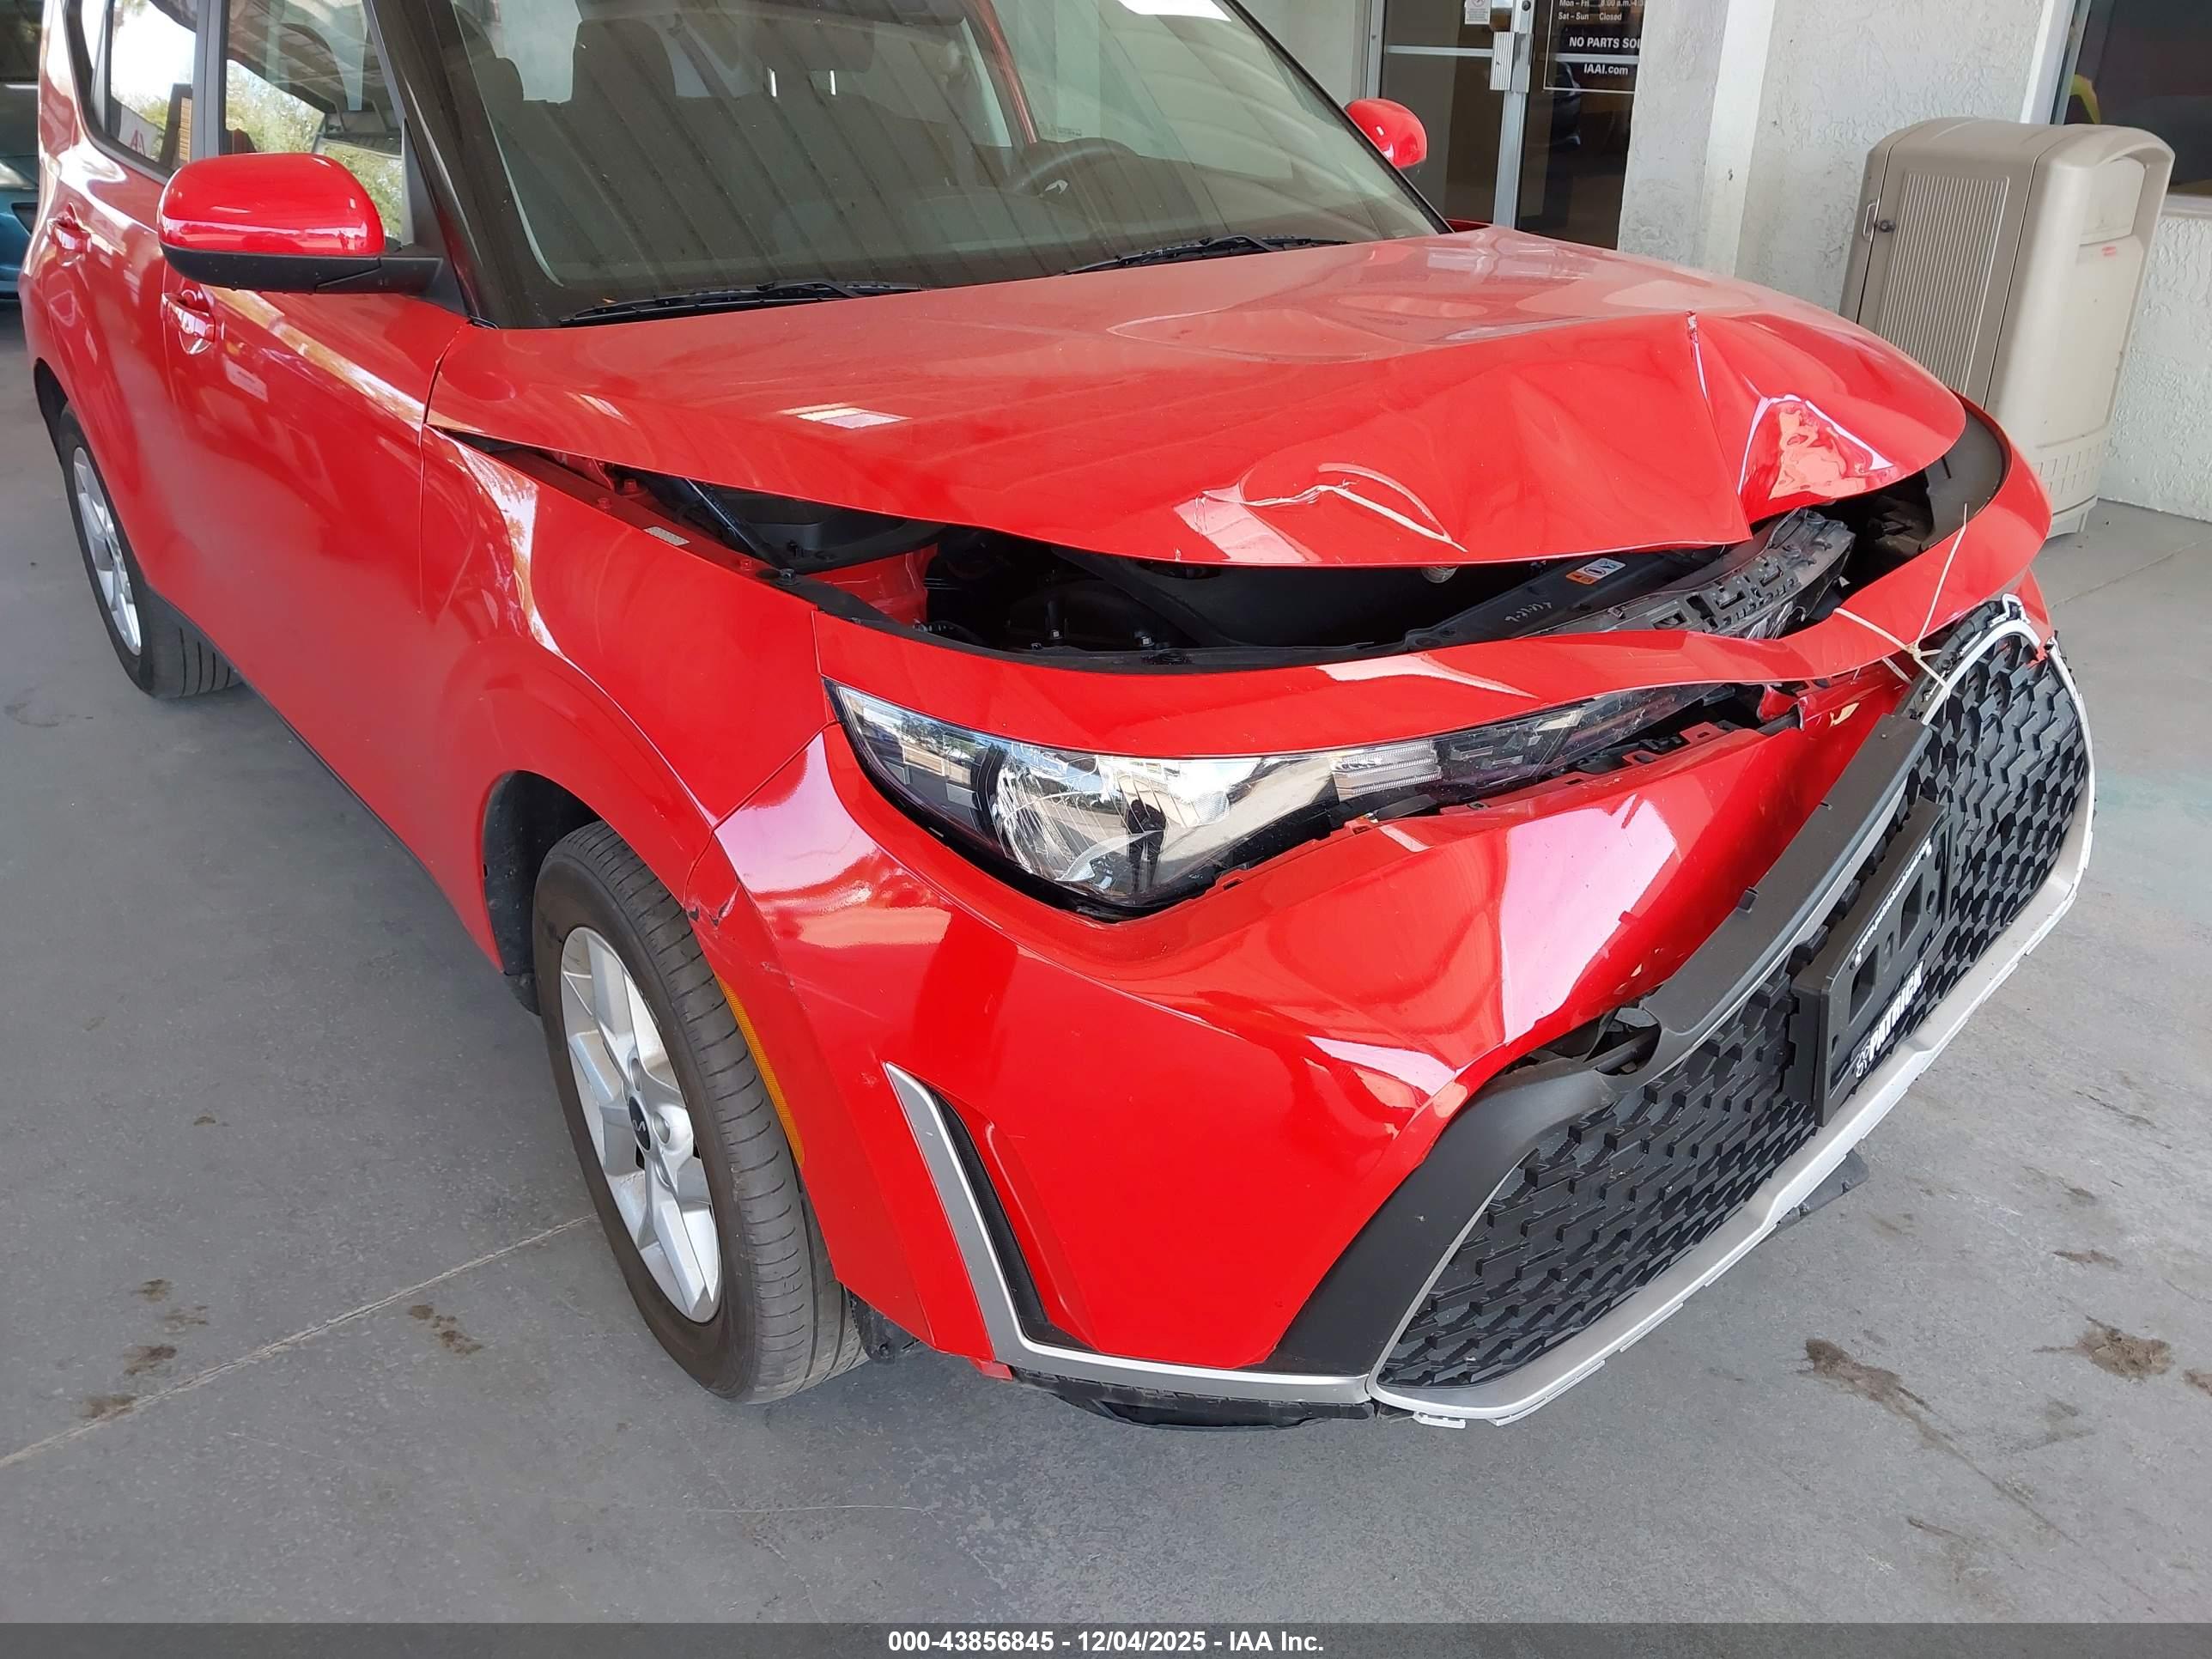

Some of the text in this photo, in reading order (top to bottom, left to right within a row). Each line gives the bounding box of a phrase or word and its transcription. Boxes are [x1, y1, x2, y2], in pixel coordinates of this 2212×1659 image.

[1569, 37, 1584, 47] NO
[1587, 37, 1620, 48] PARTS
[1583, 64, 1629, 76] IAAI.com
[1869, 960, 1923, 1062] PATRICK
